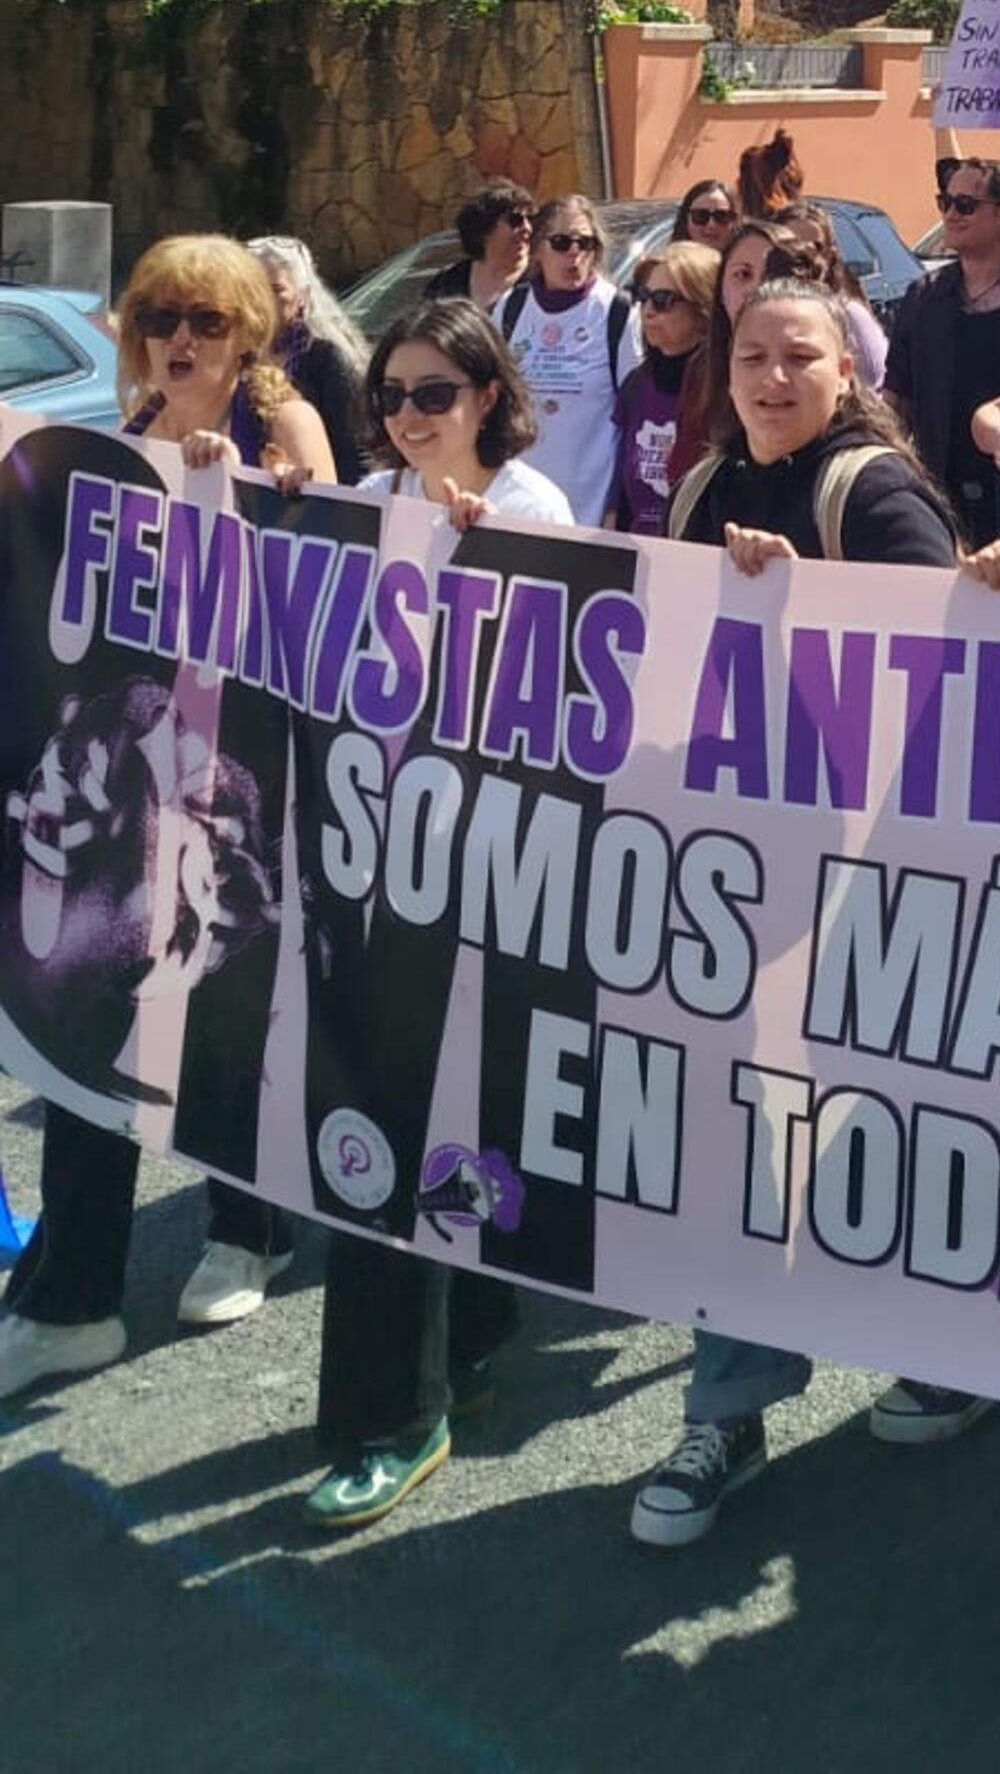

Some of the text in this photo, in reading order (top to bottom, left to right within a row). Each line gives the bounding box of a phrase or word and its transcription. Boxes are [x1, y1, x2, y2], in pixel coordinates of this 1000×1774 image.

[957, 17, 1000, 42] SIN
[58, 471, 647, 782] FEMINISTAS
[321, 732, 765, 1020] SOMOS
[520, 1008, 686, 1216] EN
